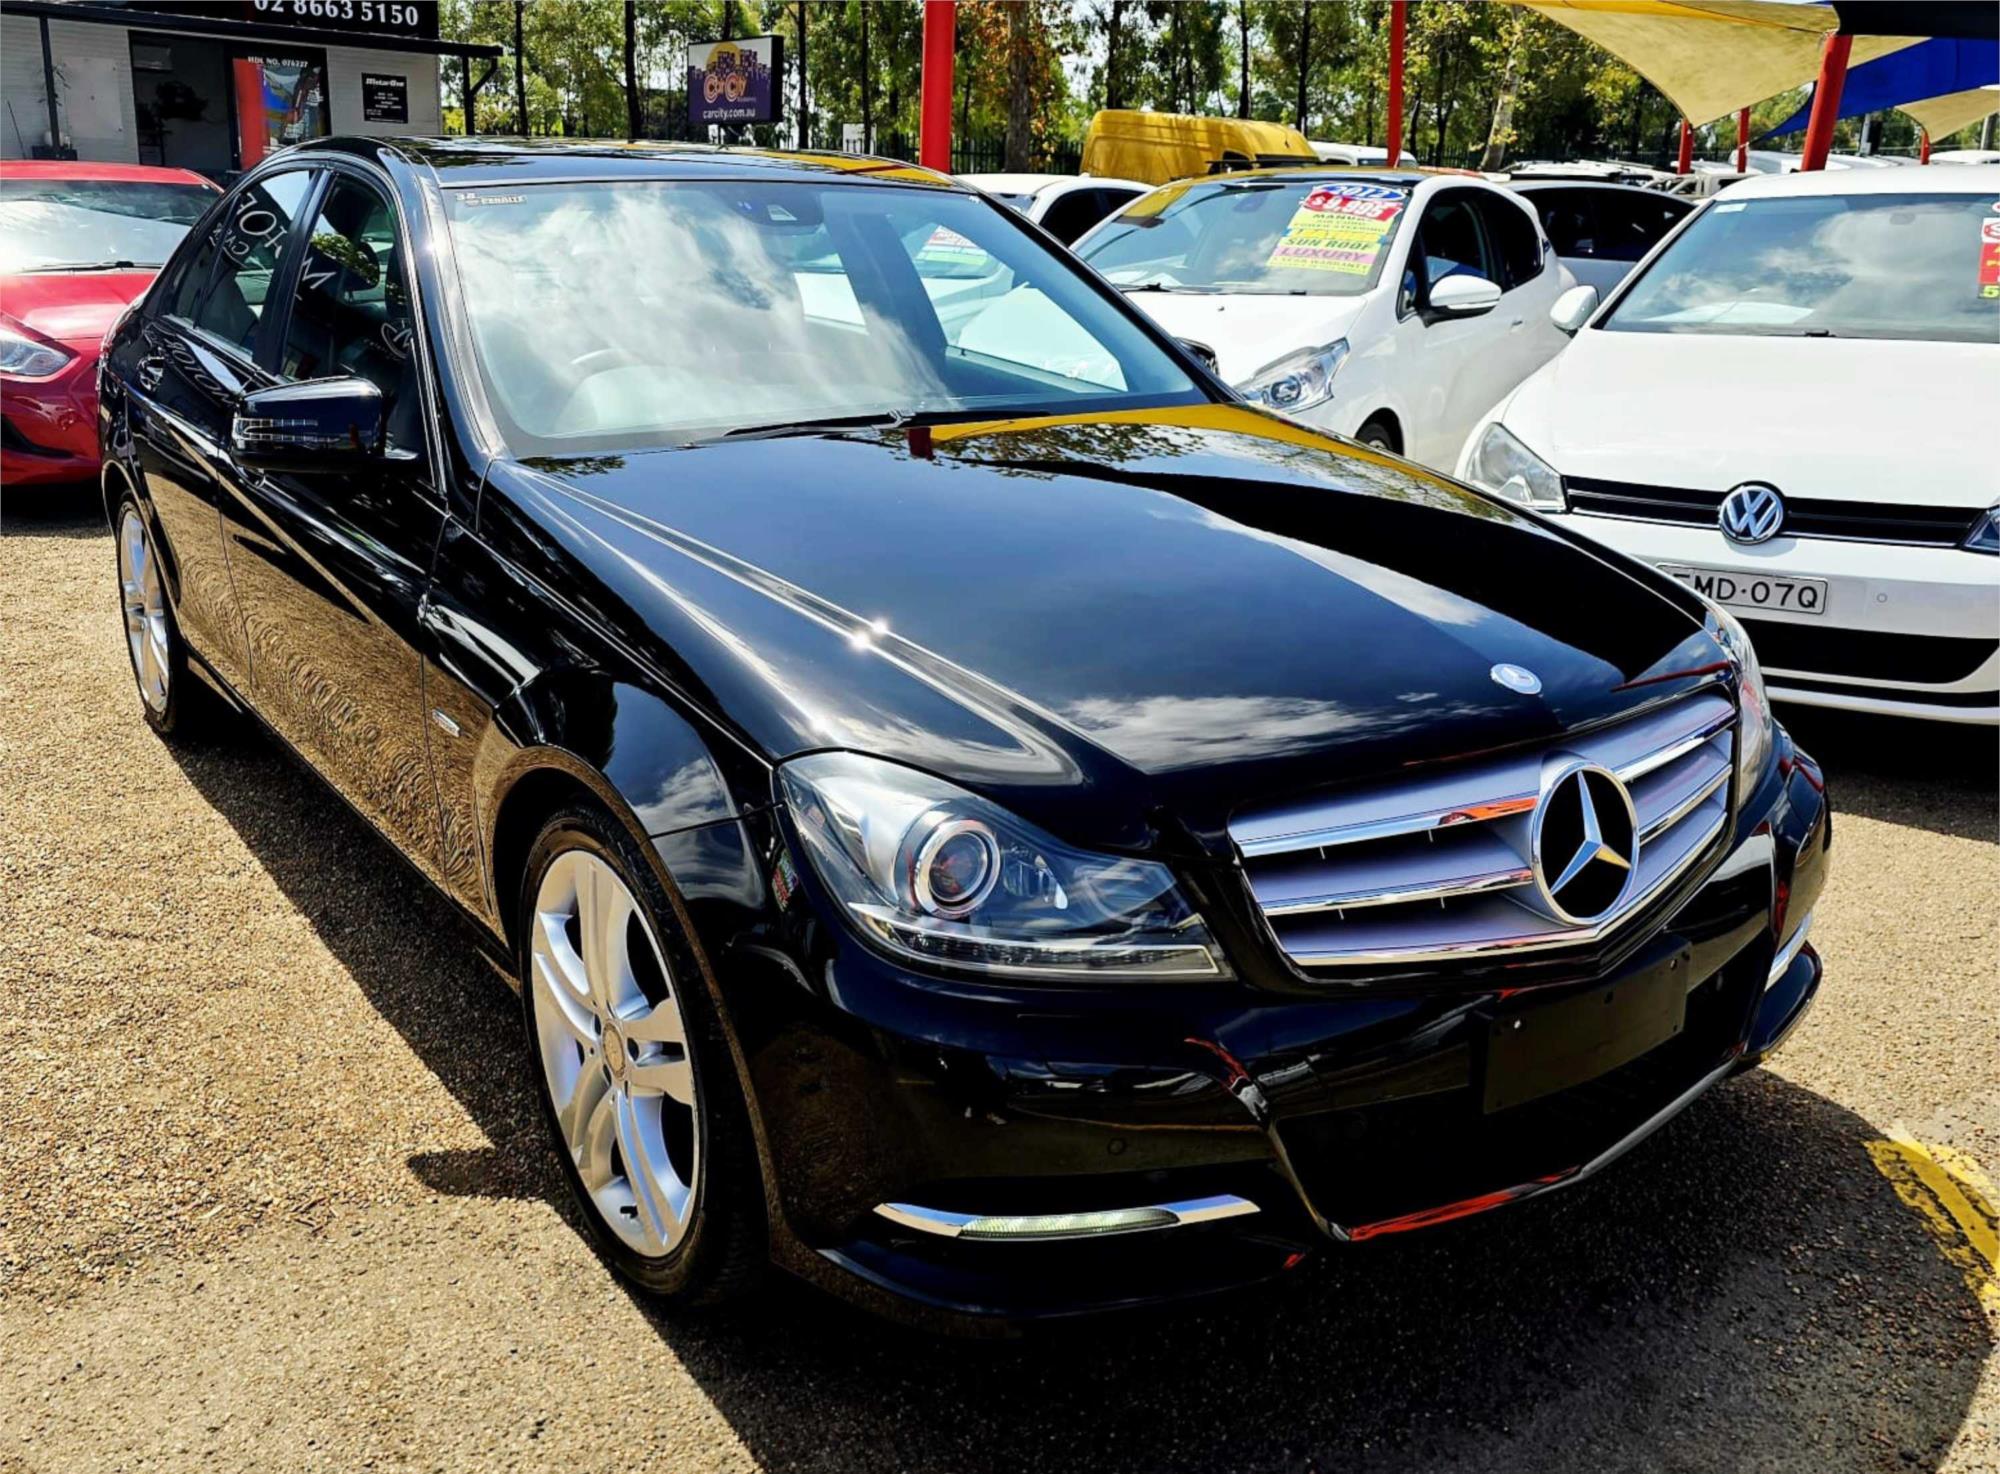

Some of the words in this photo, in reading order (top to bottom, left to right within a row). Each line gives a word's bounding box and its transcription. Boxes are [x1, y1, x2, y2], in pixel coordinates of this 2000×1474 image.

[293, 0, 354, 19] 8663
[360, 1, 419, 26] 5150
[703, 107, 756, 120] carcity.com.au
[1286, 238, 1322, 247] SUN
[1325, 240, 1370, 250] ROOF
[1280, 247, 1367, 260] LUXURY
